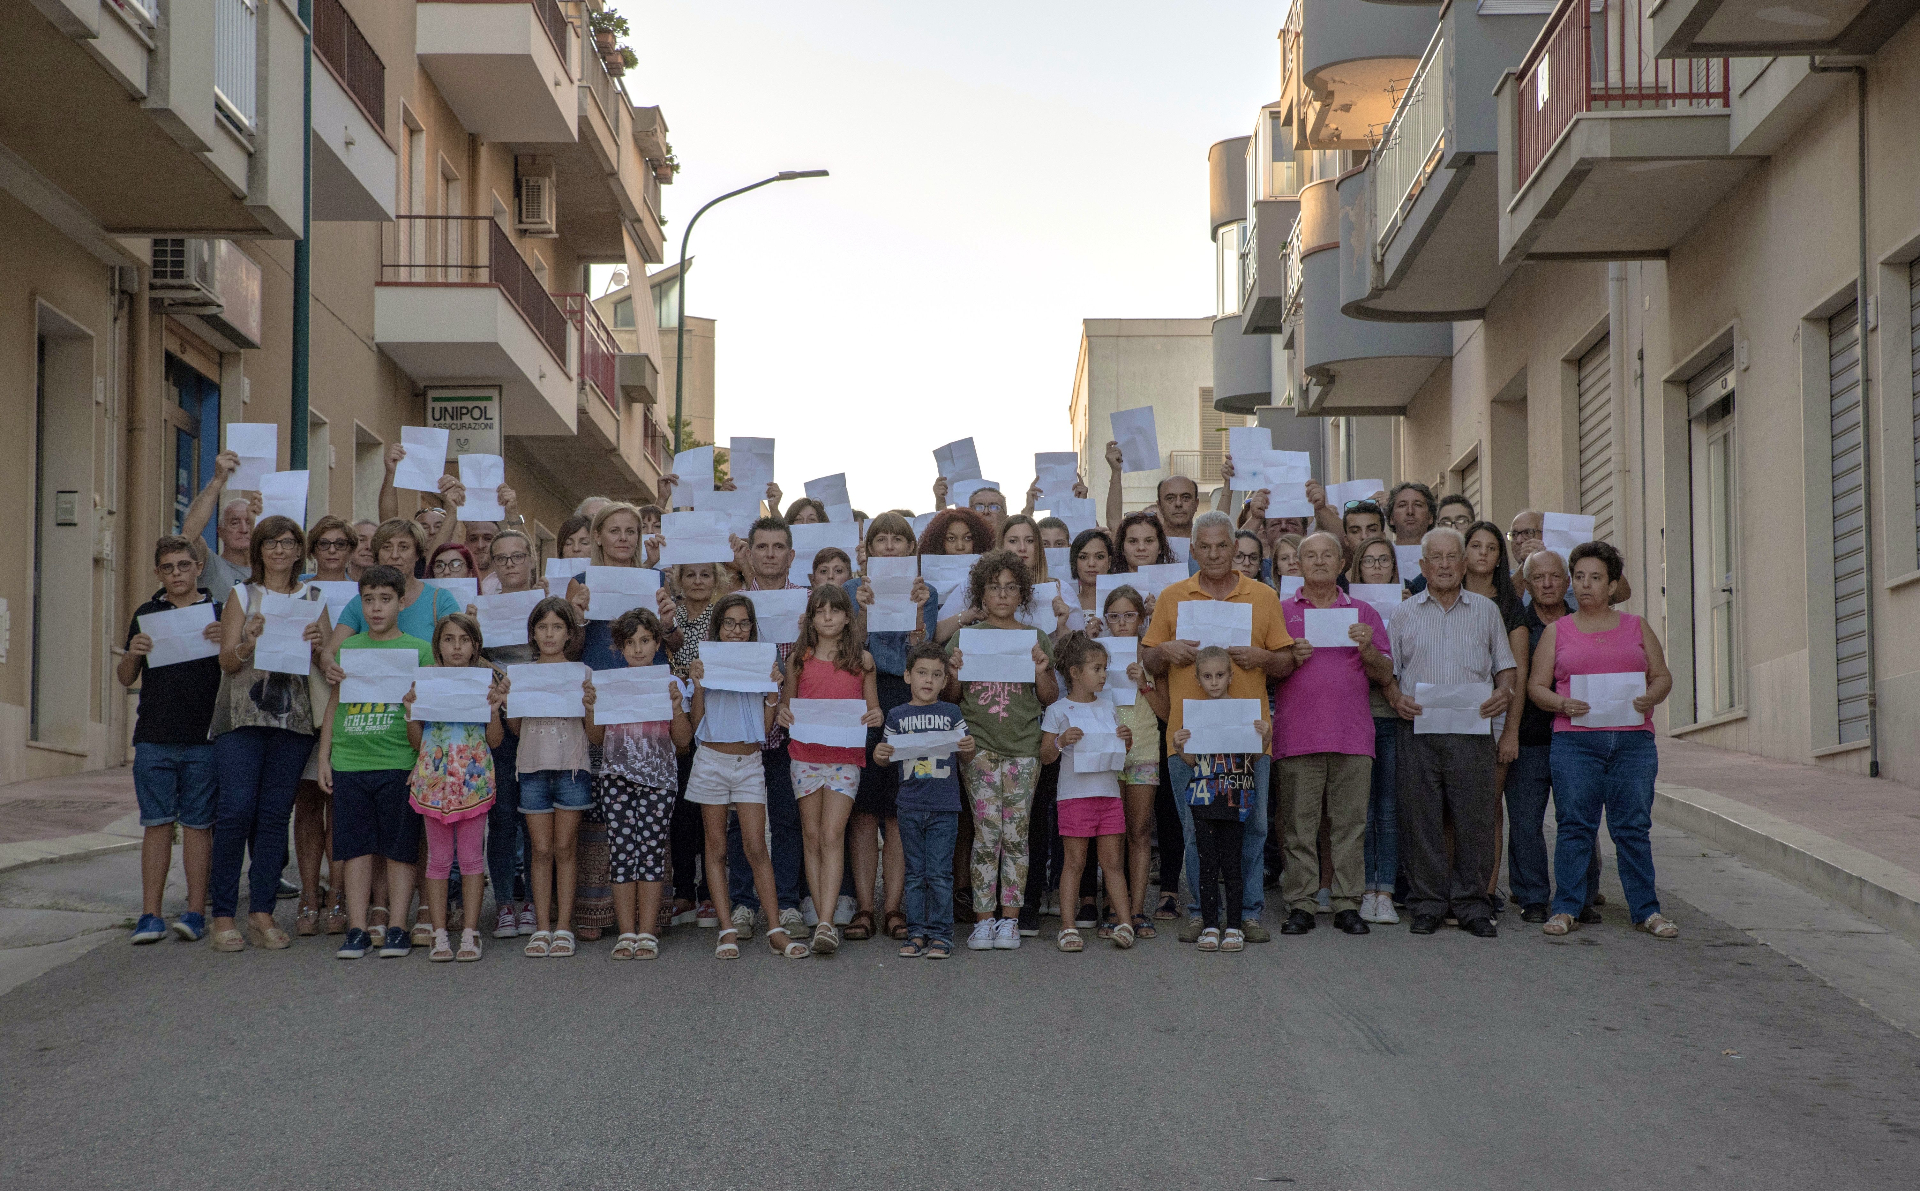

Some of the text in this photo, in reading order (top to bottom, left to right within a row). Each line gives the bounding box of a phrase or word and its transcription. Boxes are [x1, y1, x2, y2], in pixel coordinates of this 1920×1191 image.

[431, 406, 493, 421] UNIPOL
[899, 714, 951, 732] MINIONS
[1190, 778, 1211, 806] 74
